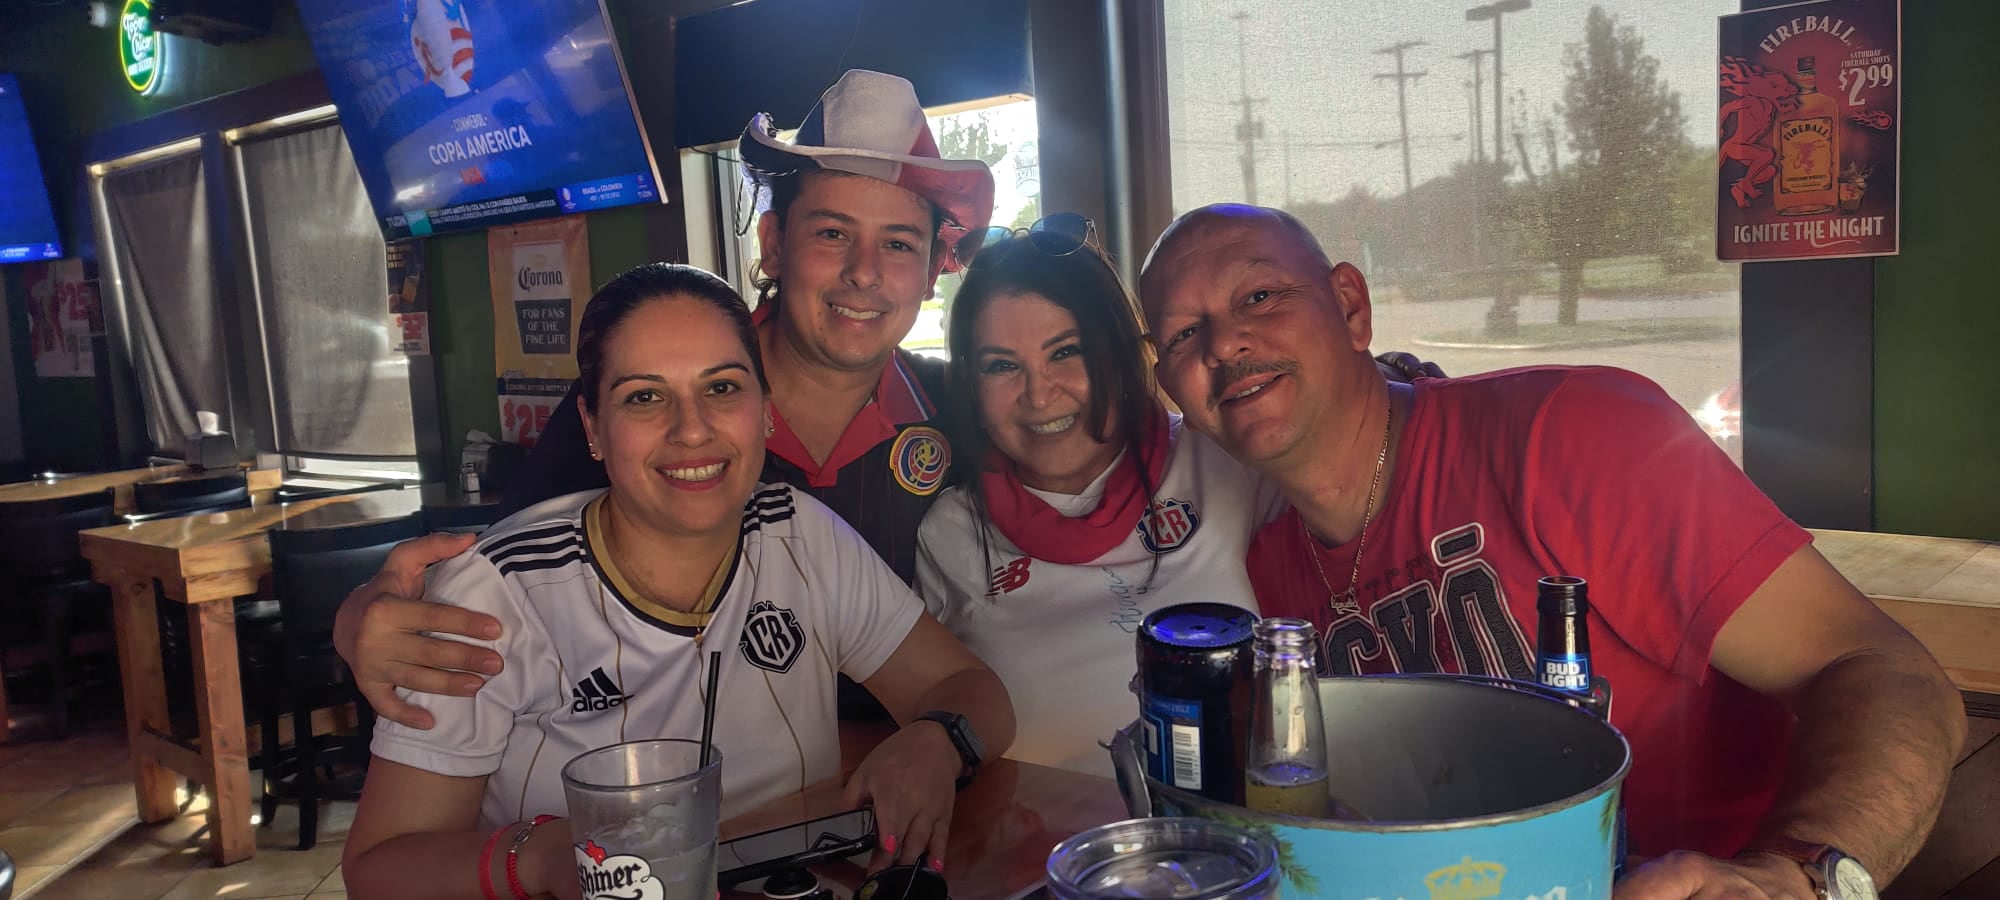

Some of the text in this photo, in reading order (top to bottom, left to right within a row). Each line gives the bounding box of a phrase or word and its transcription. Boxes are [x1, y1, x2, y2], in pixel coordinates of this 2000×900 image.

[1759, 15, 1856, 54] FIREBALL
[1850, 49, 1882, 59] SATURDAY
[1870, 55, 1890, 65] SHOTS
[1783, 123, 1830, 141] FIREBALL
[428, 124, 533, 166] COPA AMERICA
[1734, 216, 1885, 244] IGNITE THE NIGHT
[518, 265, 563, 292] Corona
[523, 308, 566, 319] FOR FANS
[527, 321, 559, 332] OF THE
[525, 334, 567, 345] FINE LIFE
[750, 615, 791, 661] CR
[1546, 661, 1580, 675] BUD
[1541, 673, 1587, 688] LIGHT
